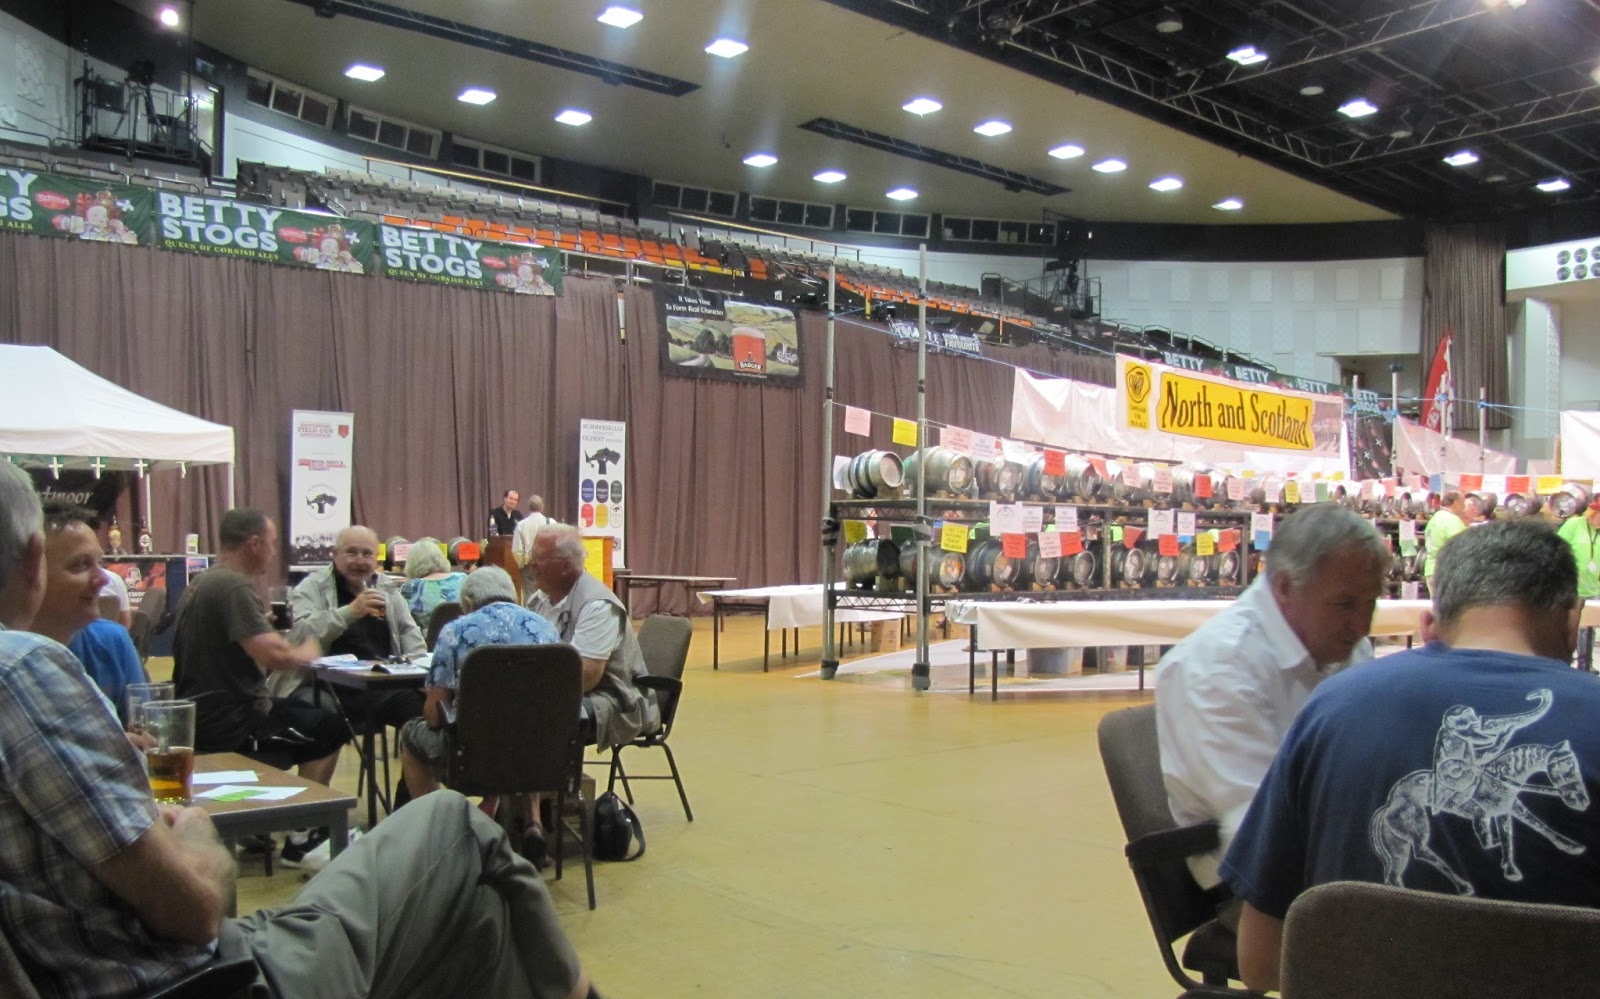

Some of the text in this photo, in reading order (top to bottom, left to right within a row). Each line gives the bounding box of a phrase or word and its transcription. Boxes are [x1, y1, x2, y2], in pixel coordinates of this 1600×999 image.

[159, 192, 283, 232] BETTY
[162, 217, 279, 251] STOGS
[381, 225, 483, 260] BETTY
[165, 239, 279, 261] QUEEN OF CORNISH ALES
[385, 249, 483, 279] STOGS
[388, 268, 415, 278] QUEEN
[673, 304, 687, 312] Form
[688, 305, 700, 313] Real
[701, 307, 724, 316] Character
[740, 361, 762, 371] BADGER
[1164, 351, 1204, 370] BETTY
[1235, 365, 1269, 384] BETTY
[1297, 377, 1328, 394] BETTY
[1161, 381, 1213, 429] North
[1218, 391, 1246, 431] and
[1251, 392, 1309, 448] Scotland
